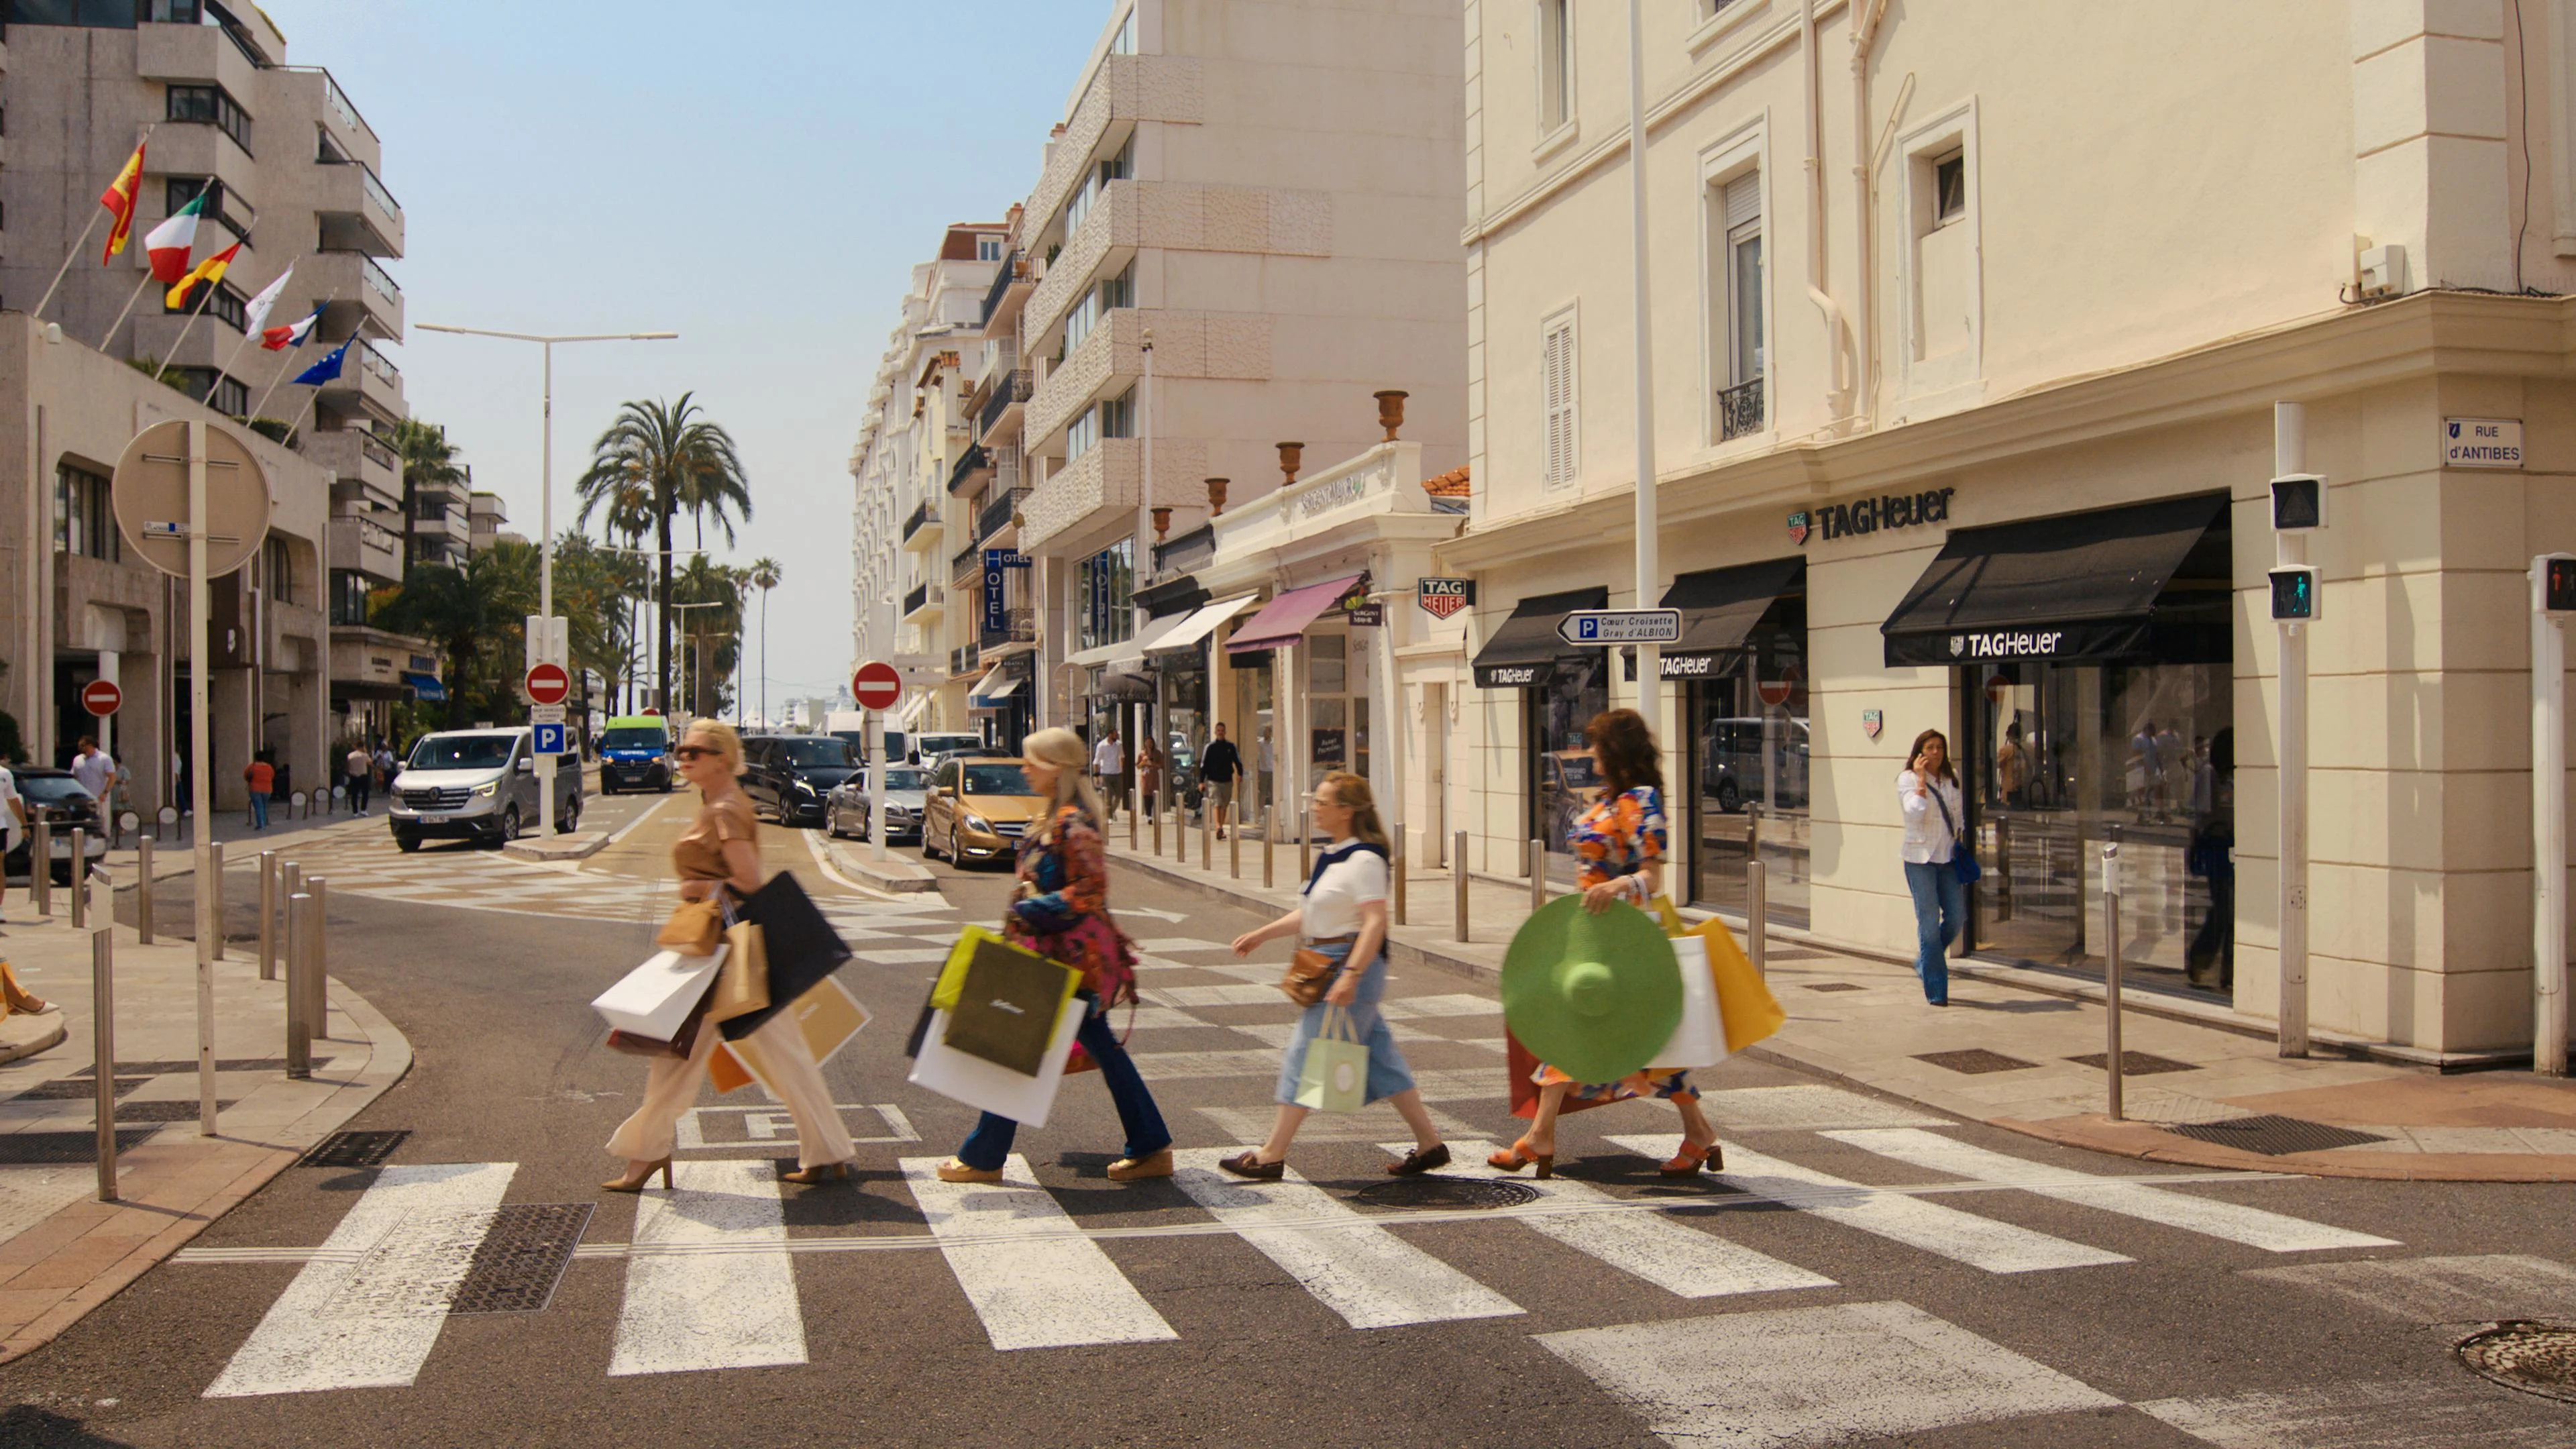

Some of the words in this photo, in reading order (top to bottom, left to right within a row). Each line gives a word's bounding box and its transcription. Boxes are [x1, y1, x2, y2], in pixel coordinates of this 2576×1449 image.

[2475, 425, 2499, 437] RUE
[2450, 446, 2520, 460] d'ANTIBES
[1789, 516, 1805, 527] TAG
[985, 550, 1001, 629] HOTEL
[1424, 582, 1462, 594] TAG
[1424, 596, 1464, 616] HEUER
[1582, 620, 1595, 636] P
[1628, 616, 1673, 625] Croisette
[1603, 629, 1624, 639] Gray
[1628, 627, 1672, 637] d'ALBION
[541, 729, 556, 749] P
